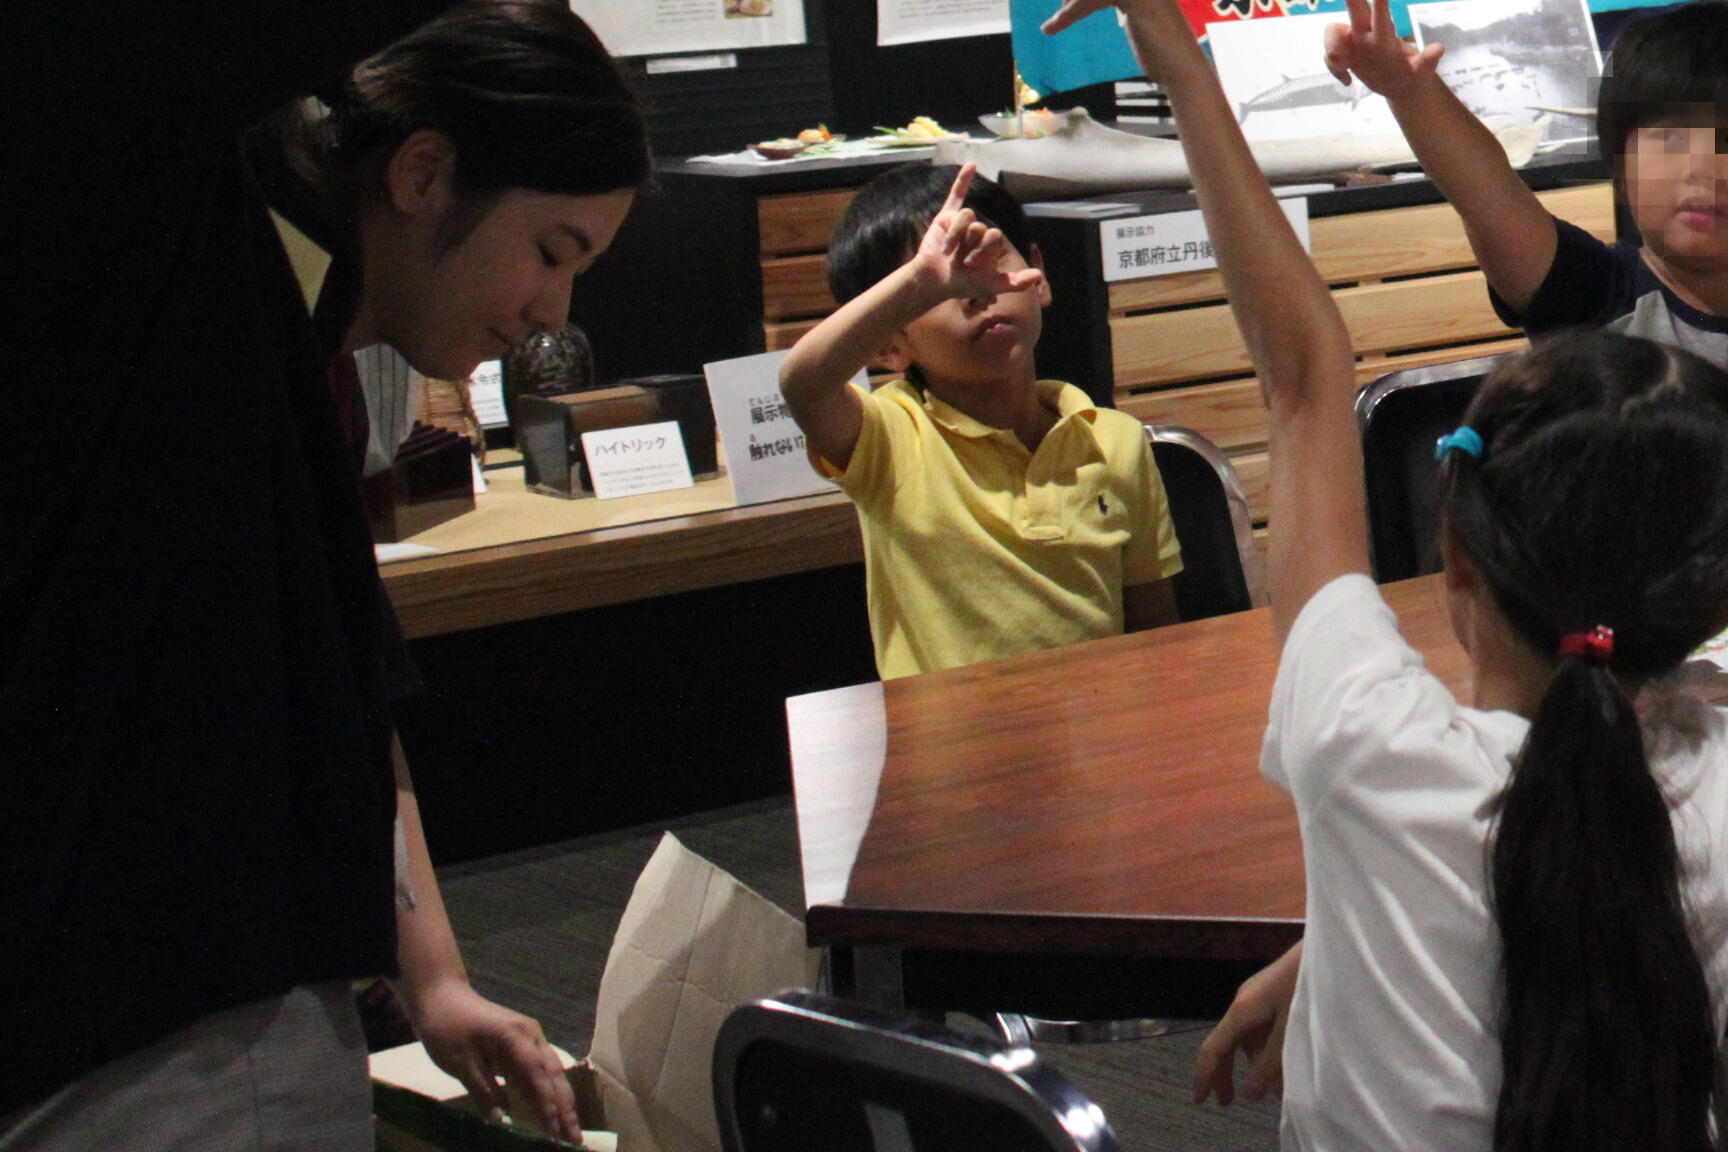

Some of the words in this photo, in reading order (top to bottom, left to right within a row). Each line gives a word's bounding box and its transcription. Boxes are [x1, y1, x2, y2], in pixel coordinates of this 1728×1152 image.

[1116, 226, 1155, 240] 展示協力
[595, 436, 666, 457] ハイトリック
